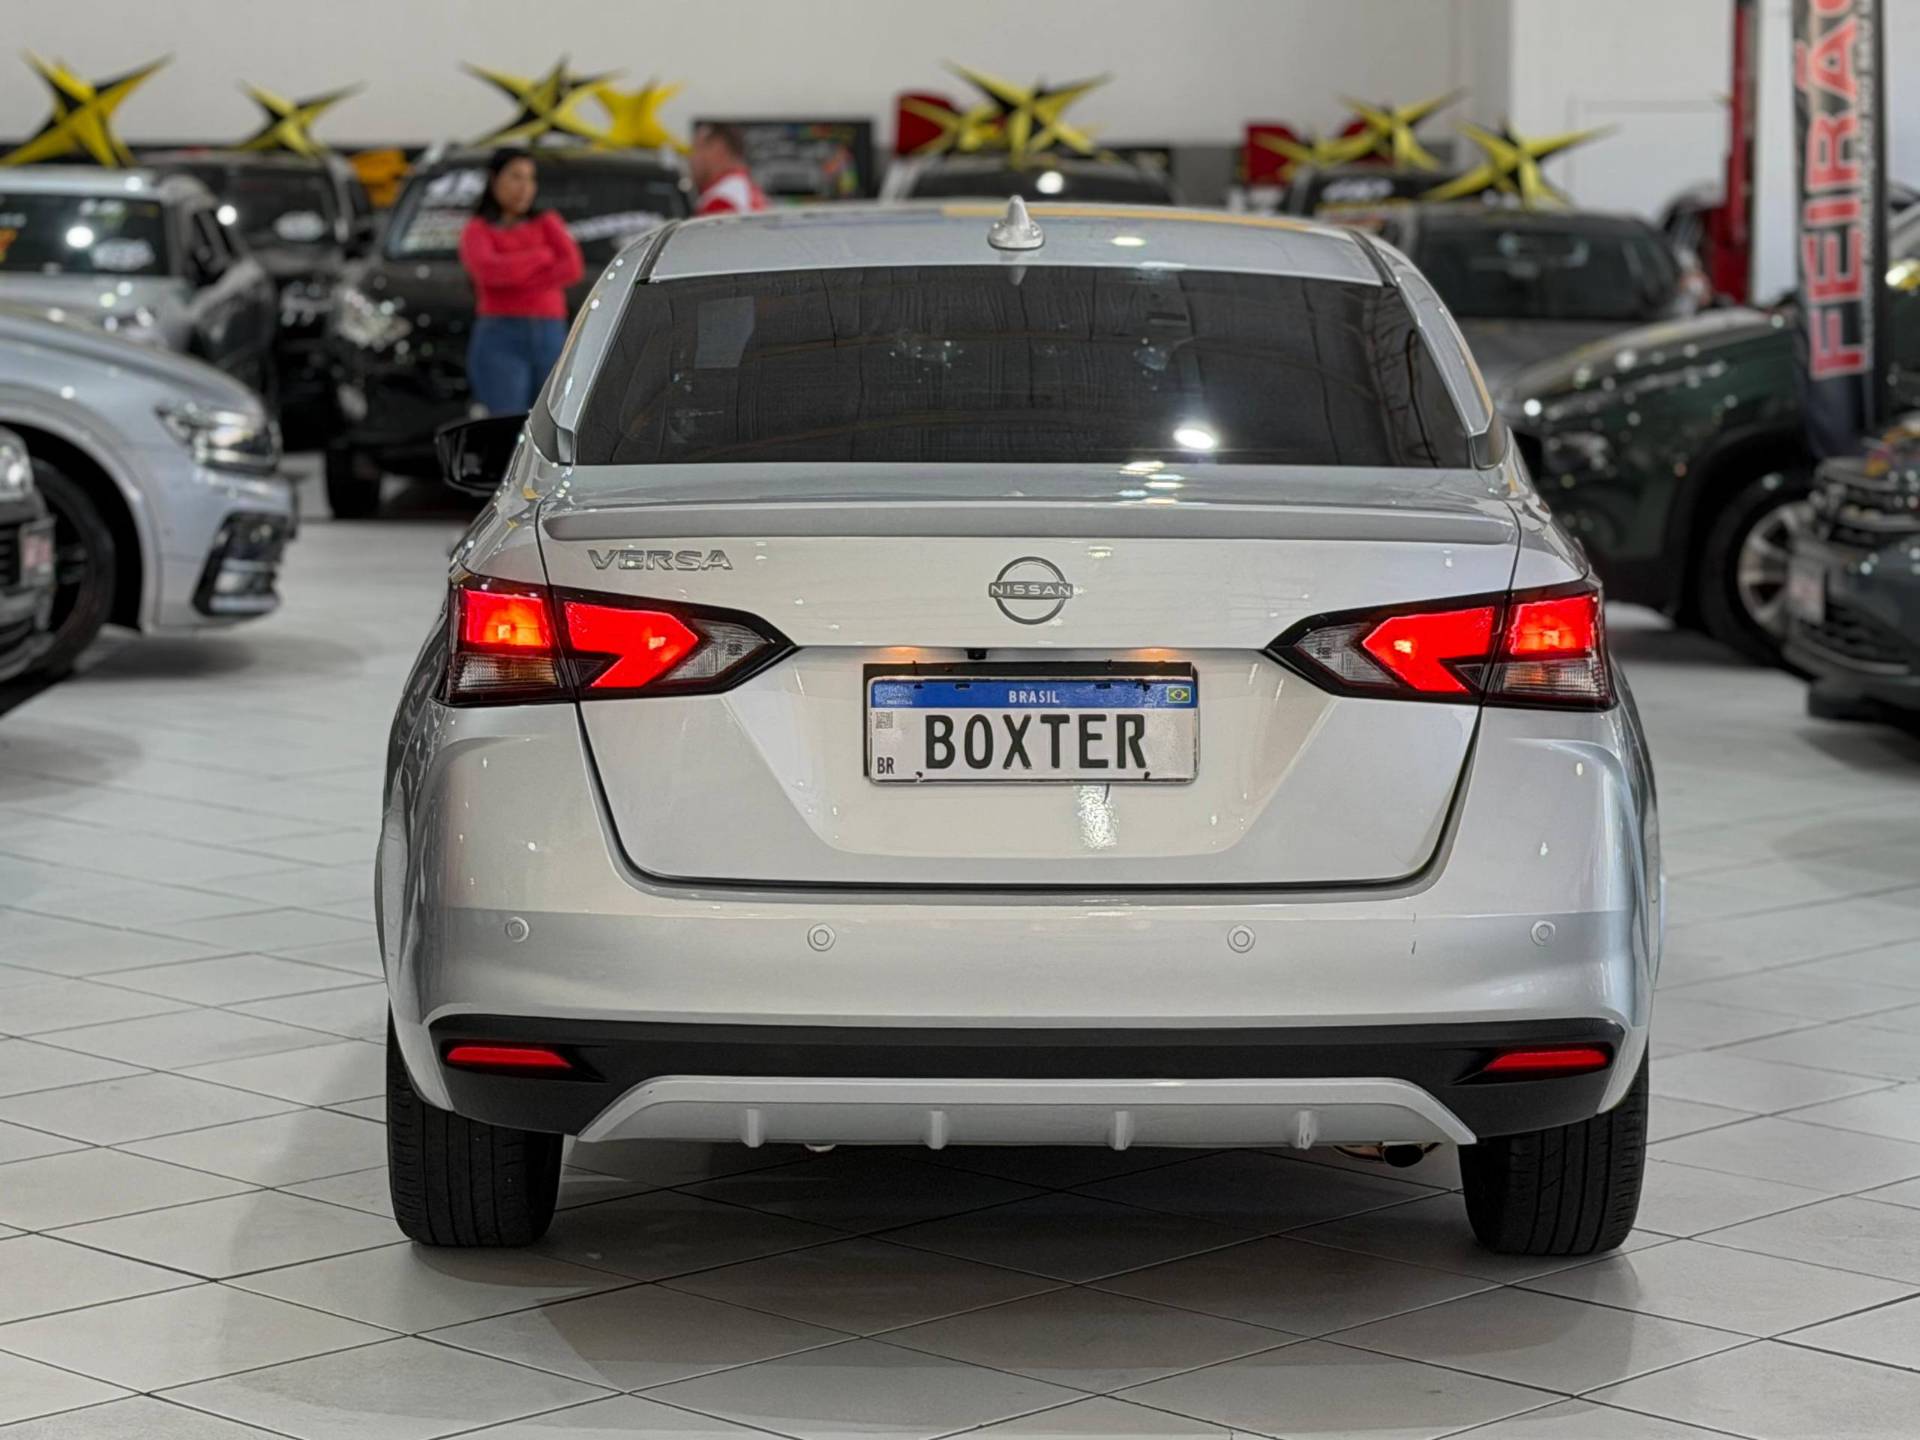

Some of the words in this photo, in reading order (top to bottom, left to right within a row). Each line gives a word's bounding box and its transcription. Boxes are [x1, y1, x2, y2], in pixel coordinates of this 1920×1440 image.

[1795, 0, 1865, 378] FEIRÃ
[587, 549, 734, 571] VERSA
[991, 584, 1071, 595] NISSAN
[1008, 690, 1060, 703] BRASIL
[925, 714, 1146, 769] BOXTER
[877, 756, 895, 774] BR
